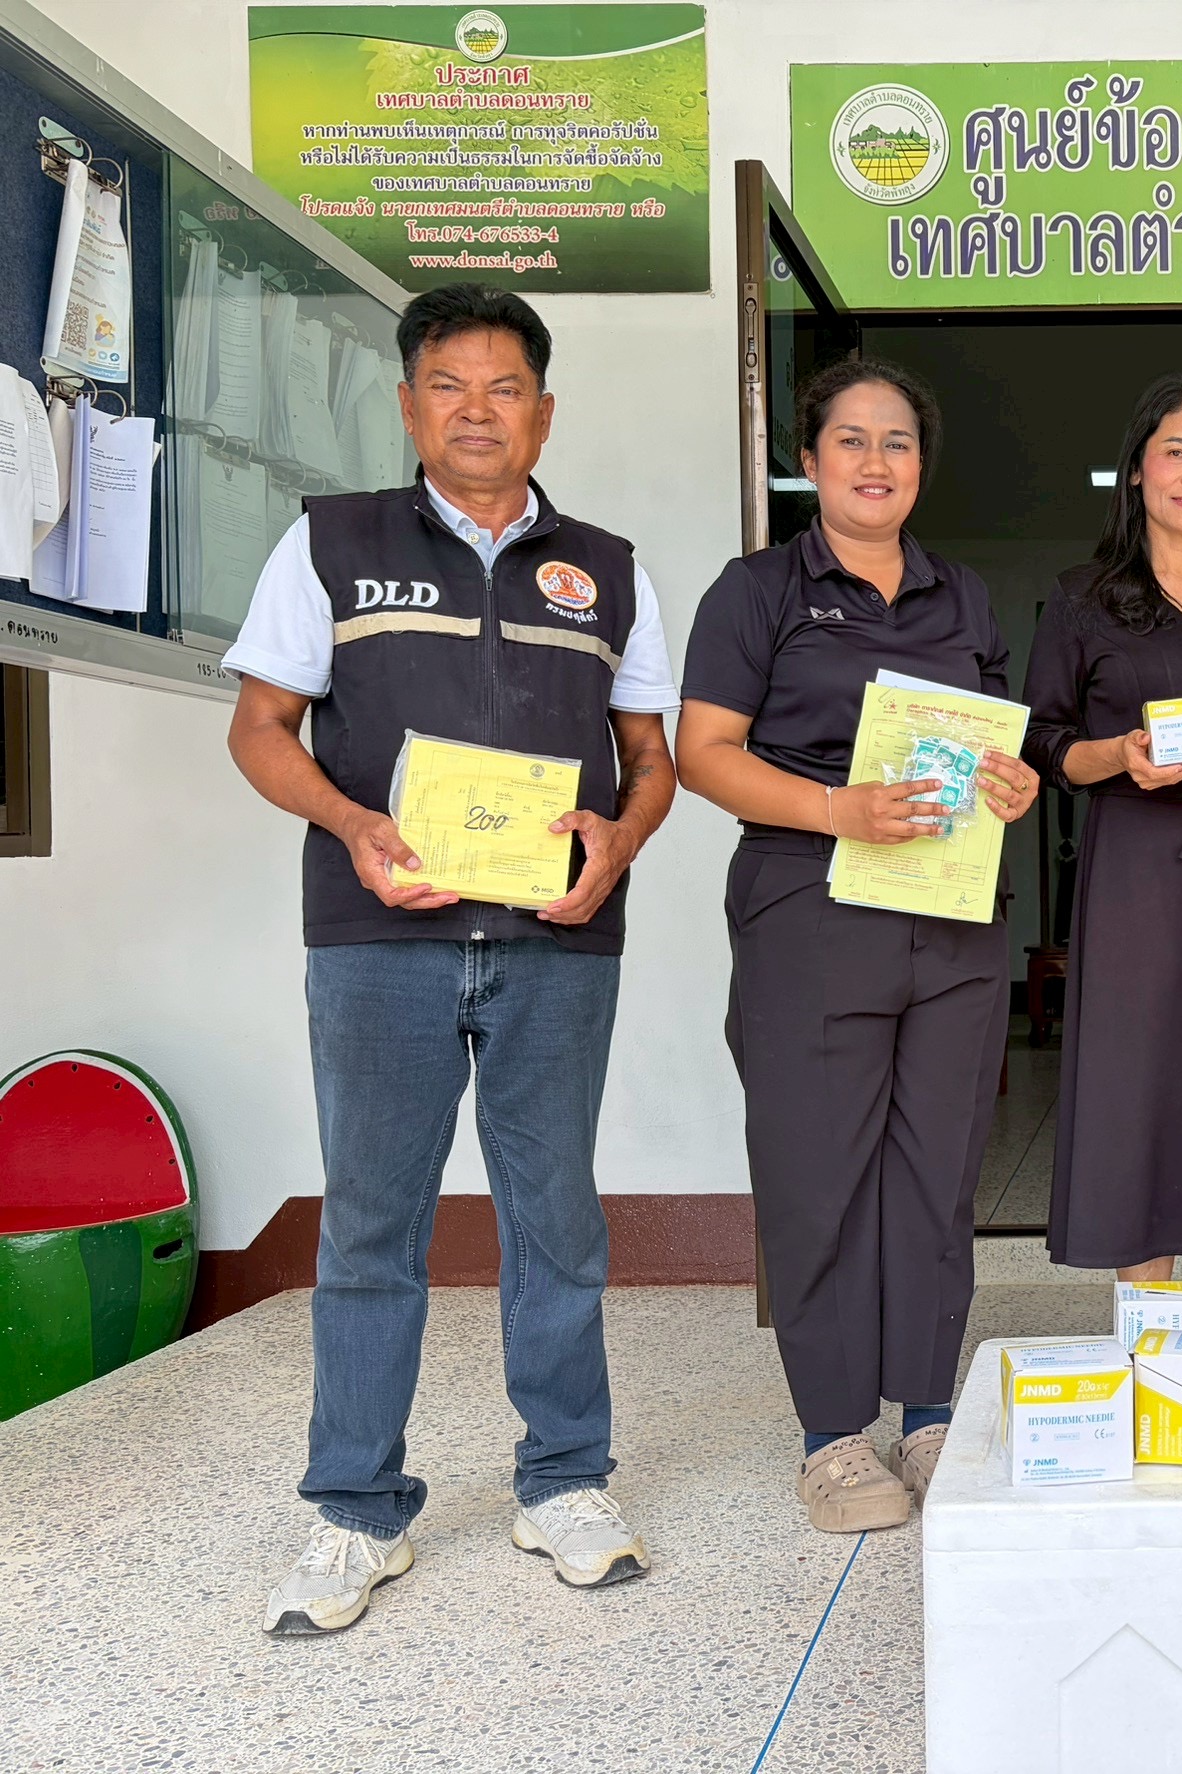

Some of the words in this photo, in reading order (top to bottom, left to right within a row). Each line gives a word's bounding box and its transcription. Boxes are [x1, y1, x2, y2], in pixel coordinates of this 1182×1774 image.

[436, 63, 530, 86] ประกาศ
[375, 89, 590, 110] เทศบาลตำบลดอนทราย
[303, 120, 505, 144] หากท่านพบเห็นเหตุการณ์
[513, 118, 658, 145] การทุจริตคอรัปชั่น
[372, 172, 591, 190] ของเทศบาลตำบลดอนทราย
[300, 194, 374, 216] โปรดแจ้ง
[382, 197, 625, 217] นายกเทศมนตรีตำบลดอนทราย
[631, 198, 665, 217] หรือ
[406, 221, 558, 243] โทร.074-676533-4
[410, 253, 557, 272] www.donsai.go.th
[354, 579, 440, 610] DLD
[464, 806, 510, 831] 200
[1021, 1384, 1062, 1397] JNMD
[1028, 1414, 1084, 1426] HYPODERMIC
[1140, 1414, 1151, 1455] JNMD
[1033, 1458, 1058, 1466] JNMD
